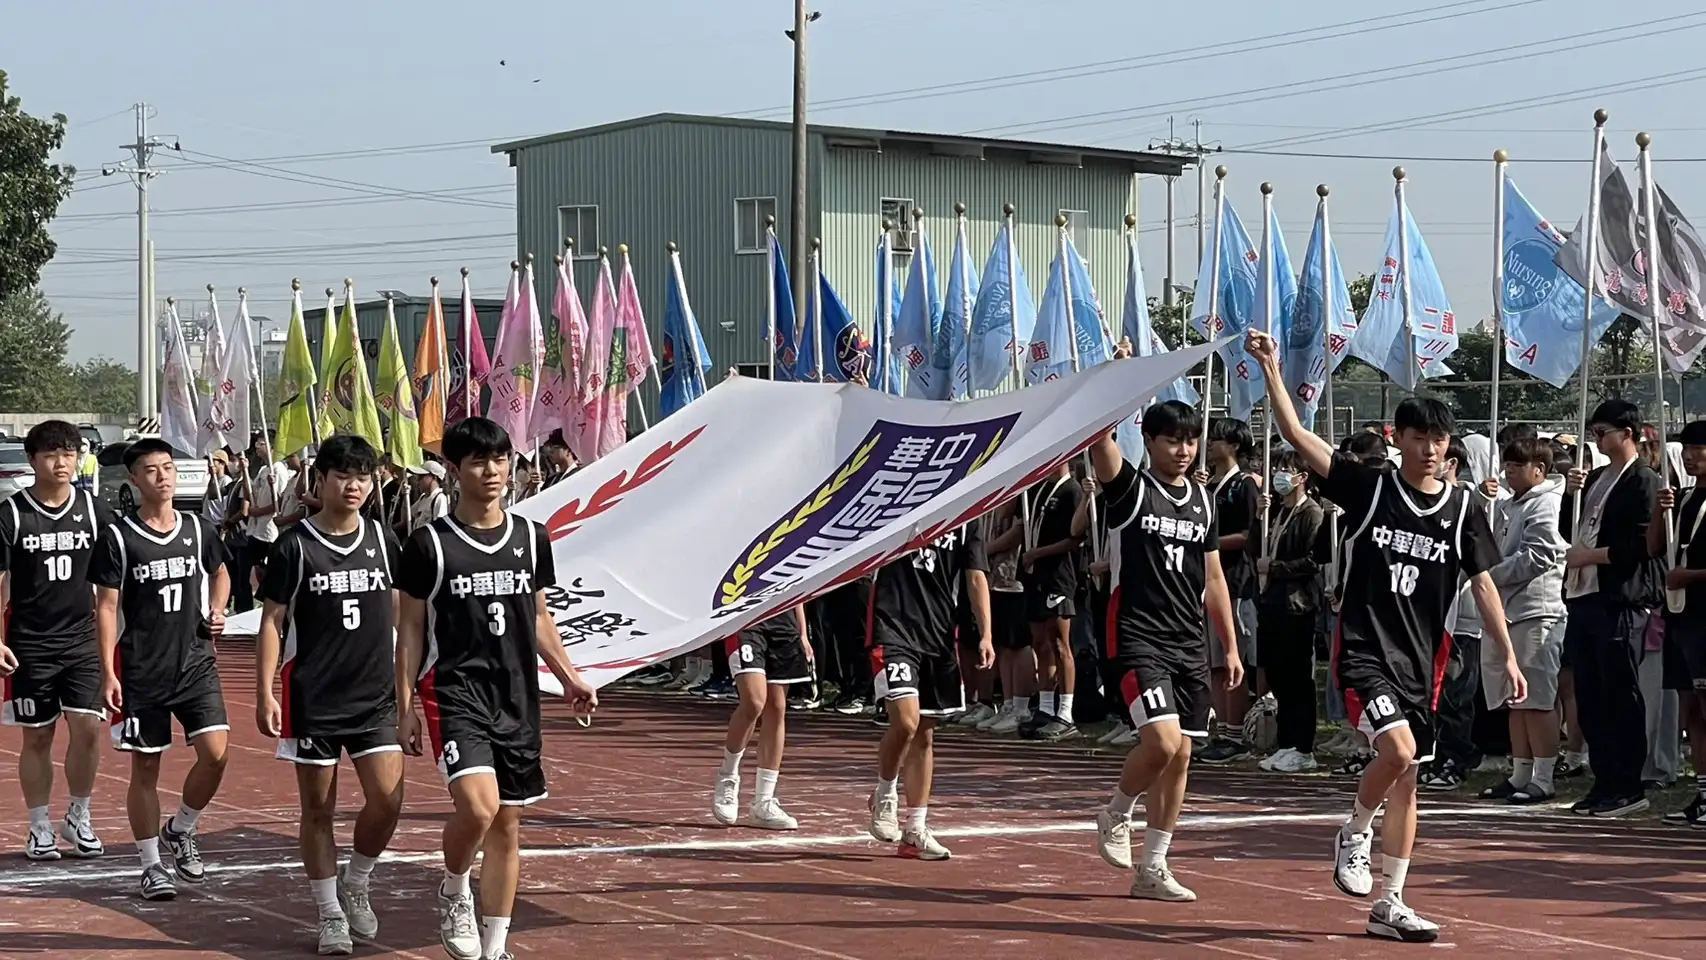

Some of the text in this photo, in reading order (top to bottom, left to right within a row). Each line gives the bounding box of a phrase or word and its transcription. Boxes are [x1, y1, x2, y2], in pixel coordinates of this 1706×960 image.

[1503, 250, 1553, 299] Nursing
[22, 530, 91, 553] 中華醫大
[1141, 513, 1206, 544] 中華醫大
[1164, 544, 1185, 573] 11
[1372, 525, 1451, 564] 中華醫大
[43, 555, 73, 581] 10
[132, 556, 197, 584] 中華醫大
[308, 567, 386, 596] 中華醫大
[1389, 562, 1420, 597] 18
[158, 583, 183, 613] 17
[450, 569, 532, 599] 中華醫大
[342, 599, 361, 630] 5
[487, 602, 506, 636] 3
[741, 644, 754, 663] 8
[888, 662, 912, 682] 23
[14, 697, 36, 717] 10
[1142, 686, 1167, 710] 11
[1366, 694, 1397, 721] 18
[443, 740, 460, 765] 3
